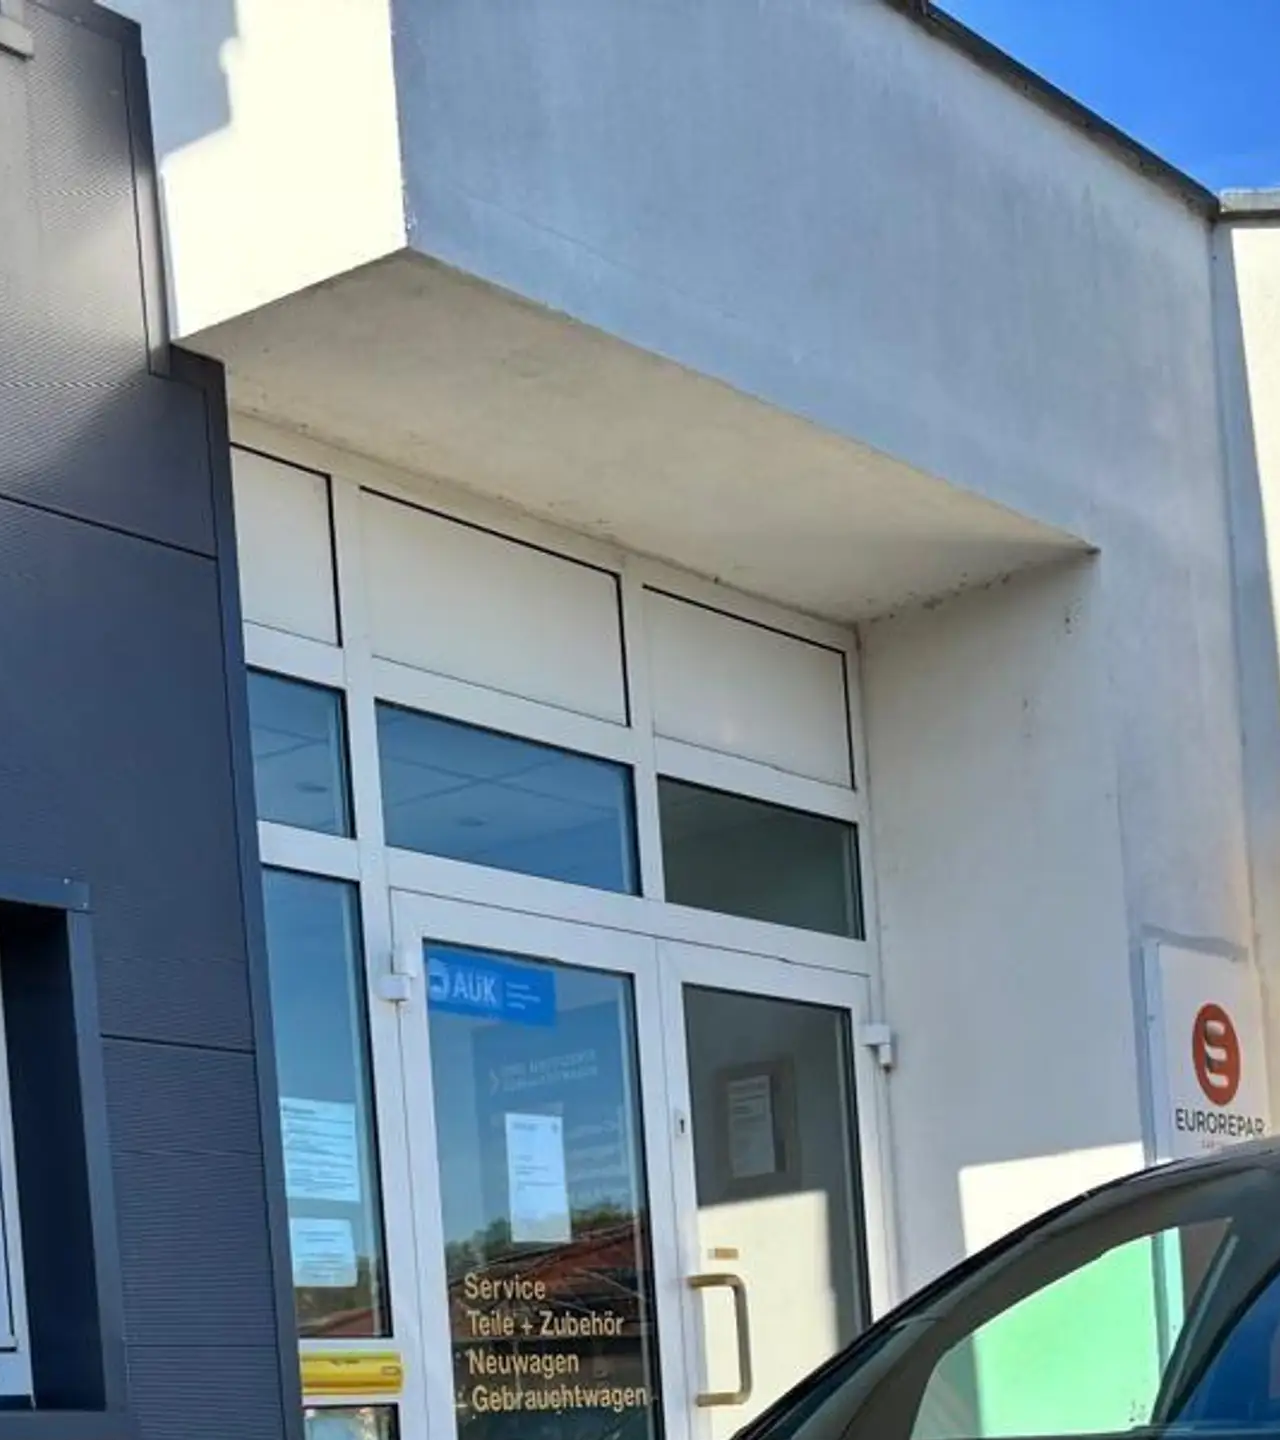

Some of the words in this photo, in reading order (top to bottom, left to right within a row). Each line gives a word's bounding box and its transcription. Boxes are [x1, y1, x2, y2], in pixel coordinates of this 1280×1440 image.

[1175, 1108, 1266, 1138] EUROREPAR
[464, 1272, 546, 1300] Service
[468, 1309, 515, 1336] Teile
[539, 1310, 625, 1336] Zubehör
[467, 1348, 580, 1380] Neuwagen
[472, 1384, 649, 1413] Gebrauchtwagen
